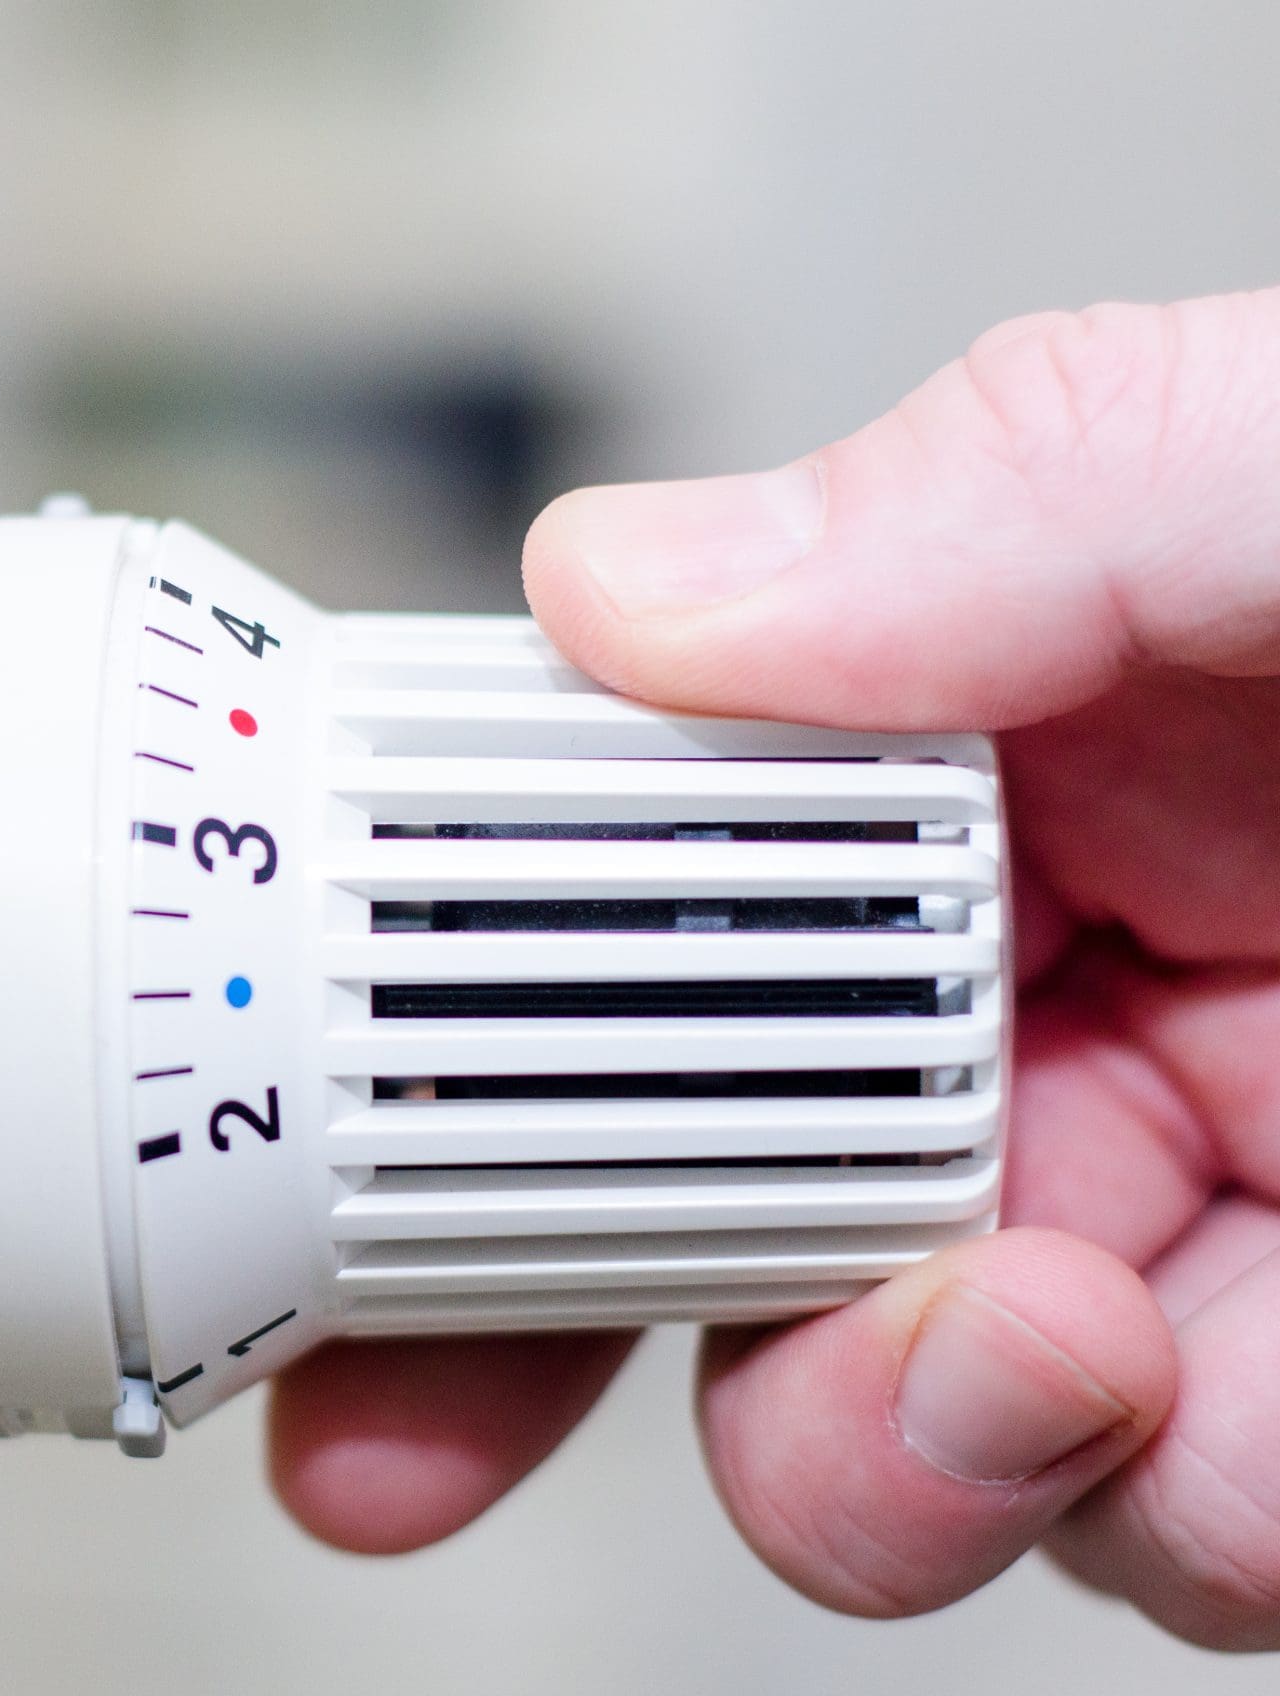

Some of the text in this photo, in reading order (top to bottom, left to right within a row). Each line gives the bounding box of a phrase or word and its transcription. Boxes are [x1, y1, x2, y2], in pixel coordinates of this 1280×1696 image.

[211, 605, 281, 660] 4
[193, 817, 278, 885] 3
[208, 1086, 281, 1152] 2
[227, 1308, 297, 1357] 1
